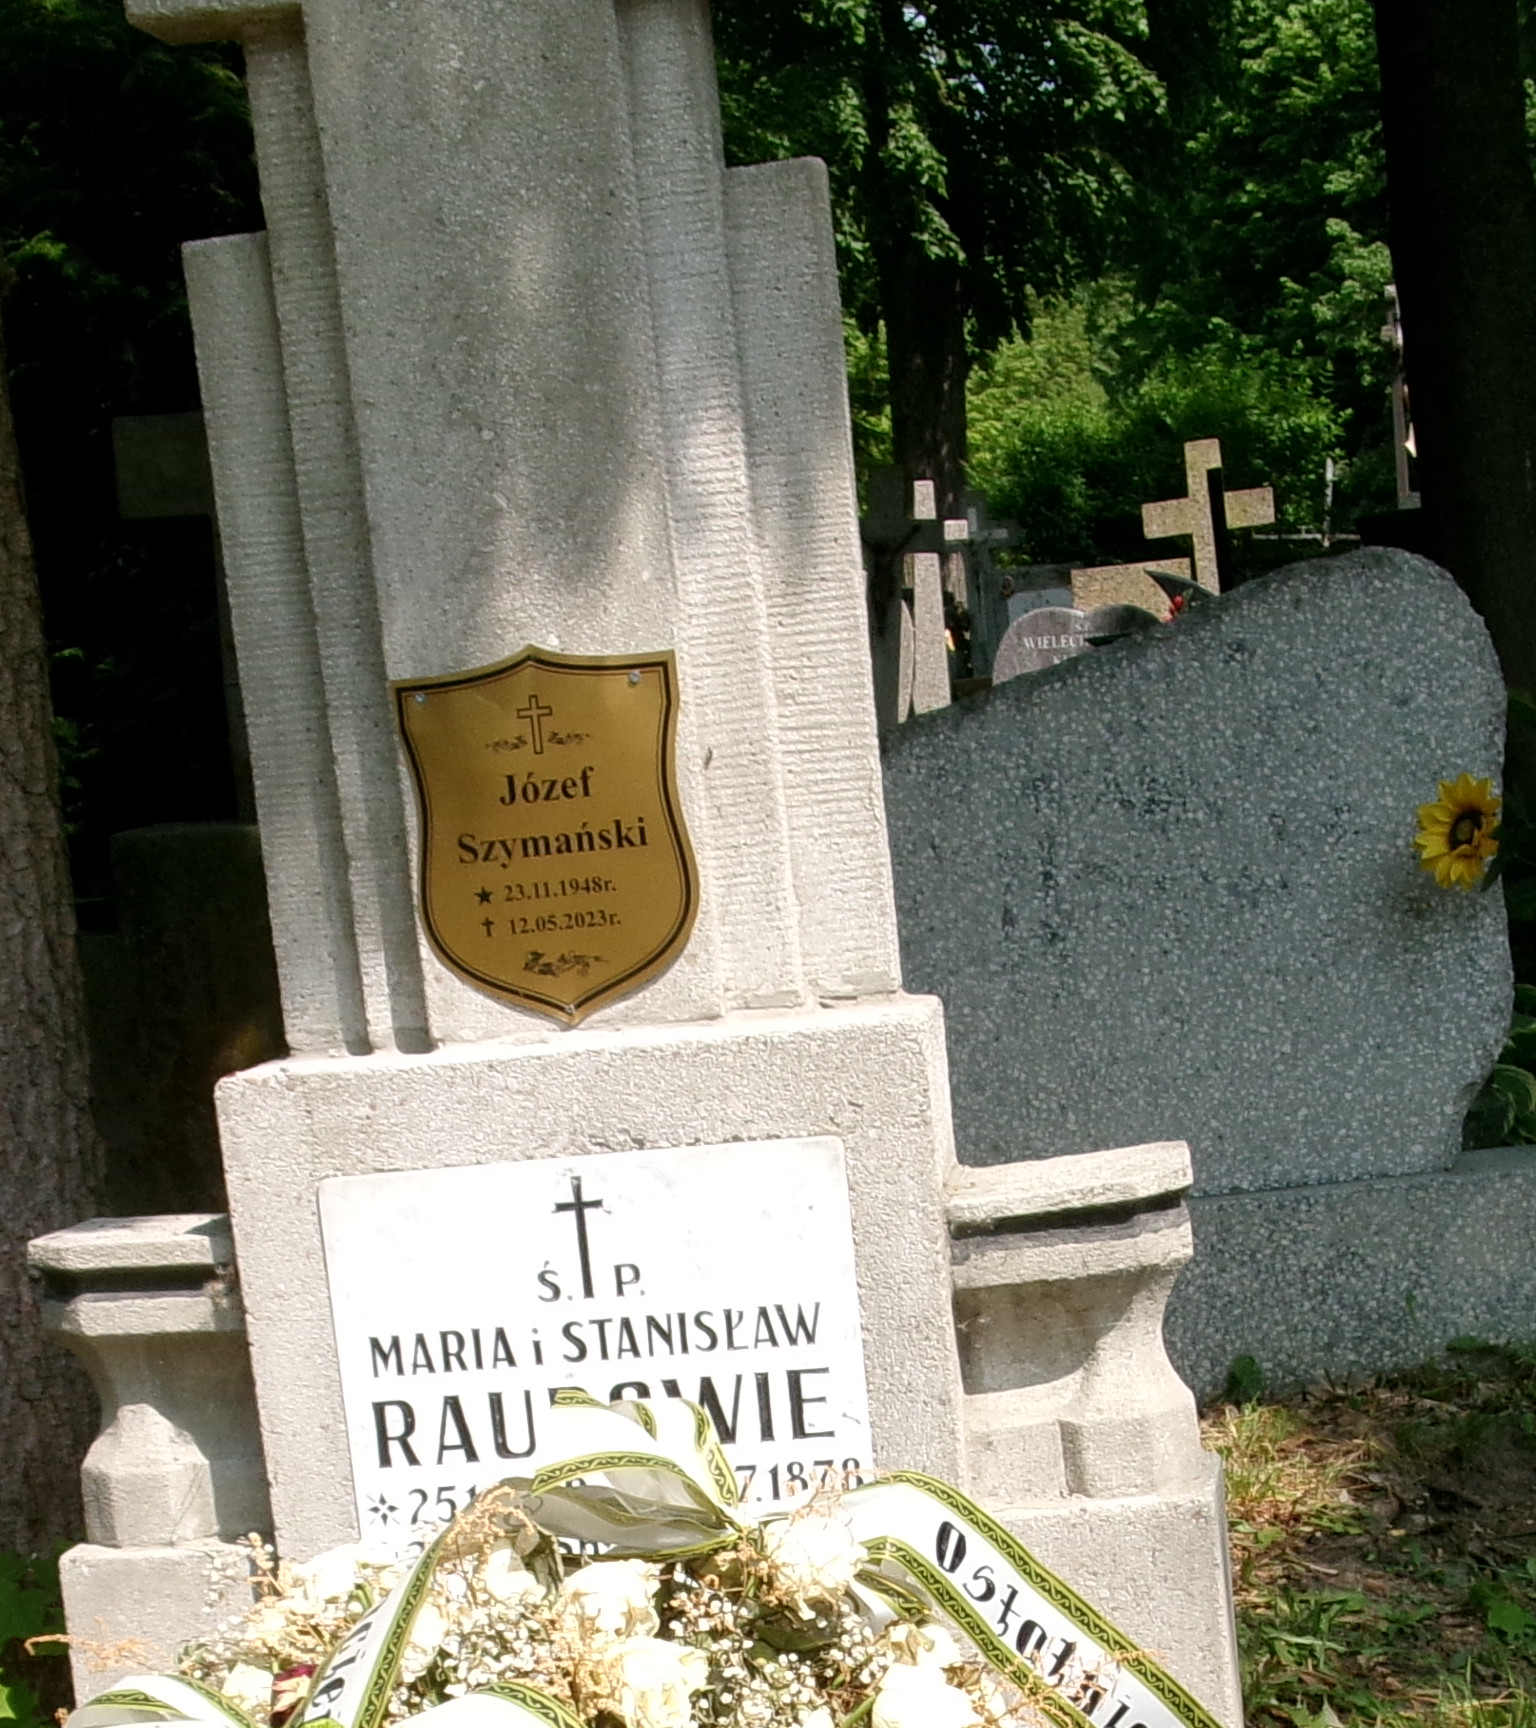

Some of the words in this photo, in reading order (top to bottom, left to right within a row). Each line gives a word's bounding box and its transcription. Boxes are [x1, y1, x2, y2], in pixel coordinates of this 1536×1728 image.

[499, 766, 596, 807] Józef
[457, 816, 649, 869] Szymański
[503, 876, 617, 903] 23.11.1948r.
[509, 909, 622, 937] 12.05.2023r.
[368, 1326, 515, 1379] MARIA
[531, 1328, 545, 1367] i
[561, 1301, 821, 1364] STANISŁAW
[371, 1367, 837, 1470] RAUWIE
